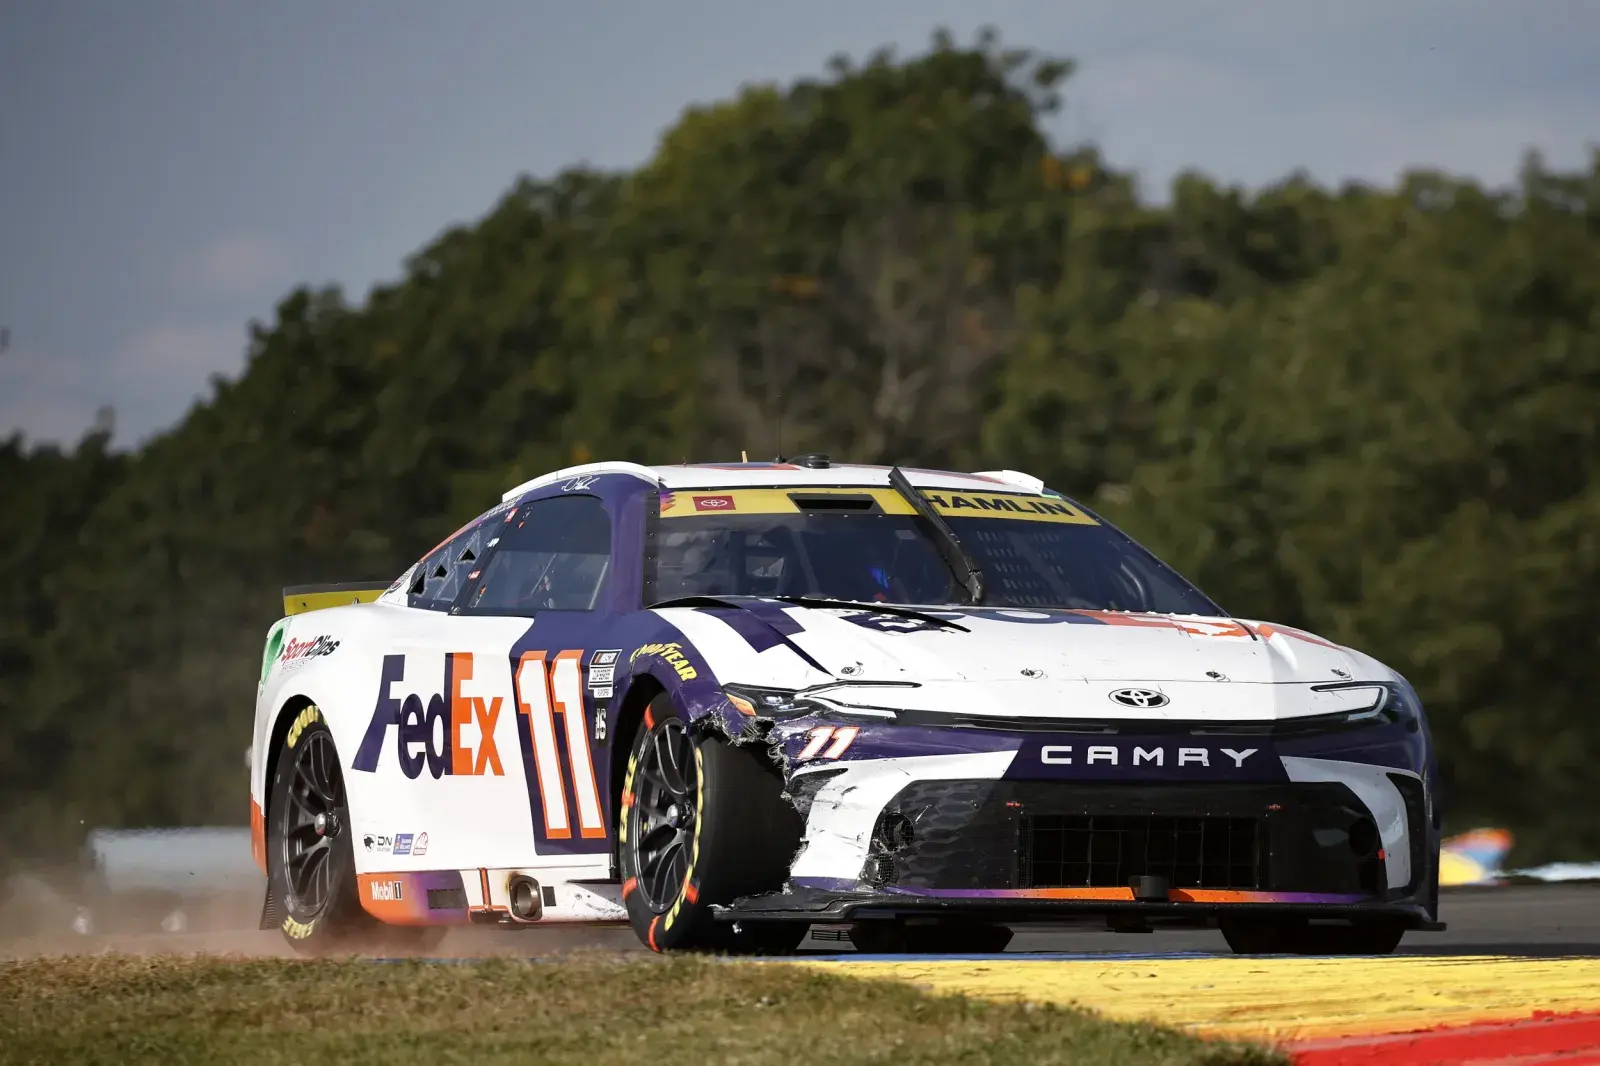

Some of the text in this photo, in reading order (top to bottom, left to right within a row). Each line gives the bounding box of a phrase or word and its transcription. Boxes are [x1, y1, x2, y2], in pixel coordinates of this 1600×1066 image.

[921, 495, 1076, 517] HAMLIN
[352, 652, 505, 780] FedEx
[515, 649, 607, 839] 11
[798, 725, 860, 760] 11
[1040, 745, 1259, 768] CAMRY
[370, 881, 394, 901] Mobil
